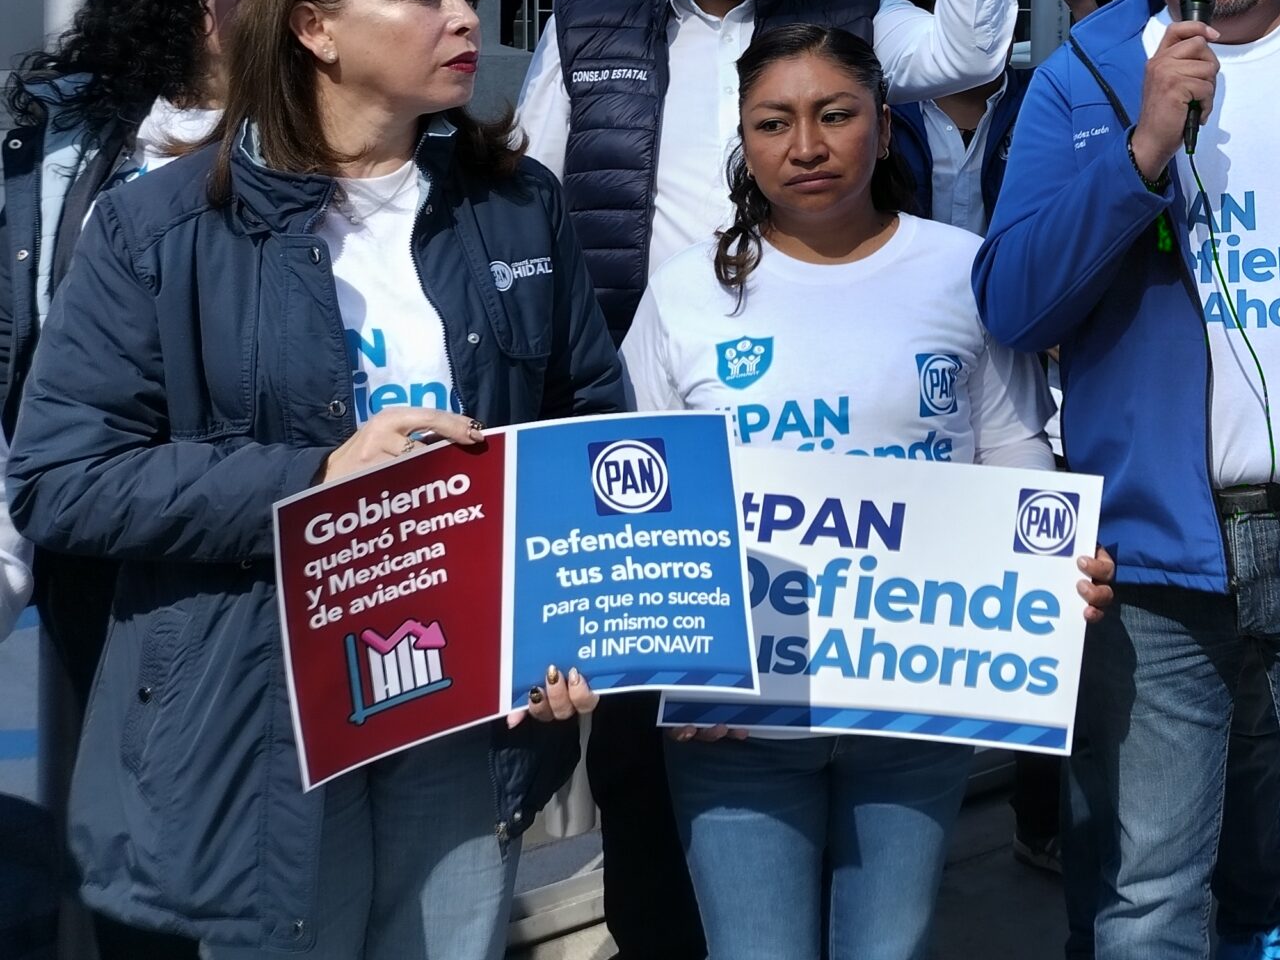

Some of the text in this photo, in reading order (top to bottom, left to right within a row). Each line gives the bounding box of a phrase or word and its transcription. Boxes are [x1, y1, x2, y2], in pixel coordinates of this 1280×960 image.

[572, 68, 648, 83] CONSEJO ESTATAL
[513, 261, 553, 279] HIDAL
[732, 396, 850, 444] PAN
[604, 458, 656, 496] PAN
[304, 473, 471, 545] Gobierno
[1025, 505, 1067, 540] PAN
[303, 503, 485, 580] quebró Pemex
[525, 523, 732, 561] Defenderemos
[306, 542, 446, 611] y Mexicana
[556, 556, 713, 588] tus ahorros
[308, 568, 448, 629] de aviación
[542, 587, 730, 623] para que no suceda
[579, 613, 705, 635] lo mismo con
[577, 635, 714, 659] el INFONAVIT
[757, 627, 1060, 696] sAhorros
